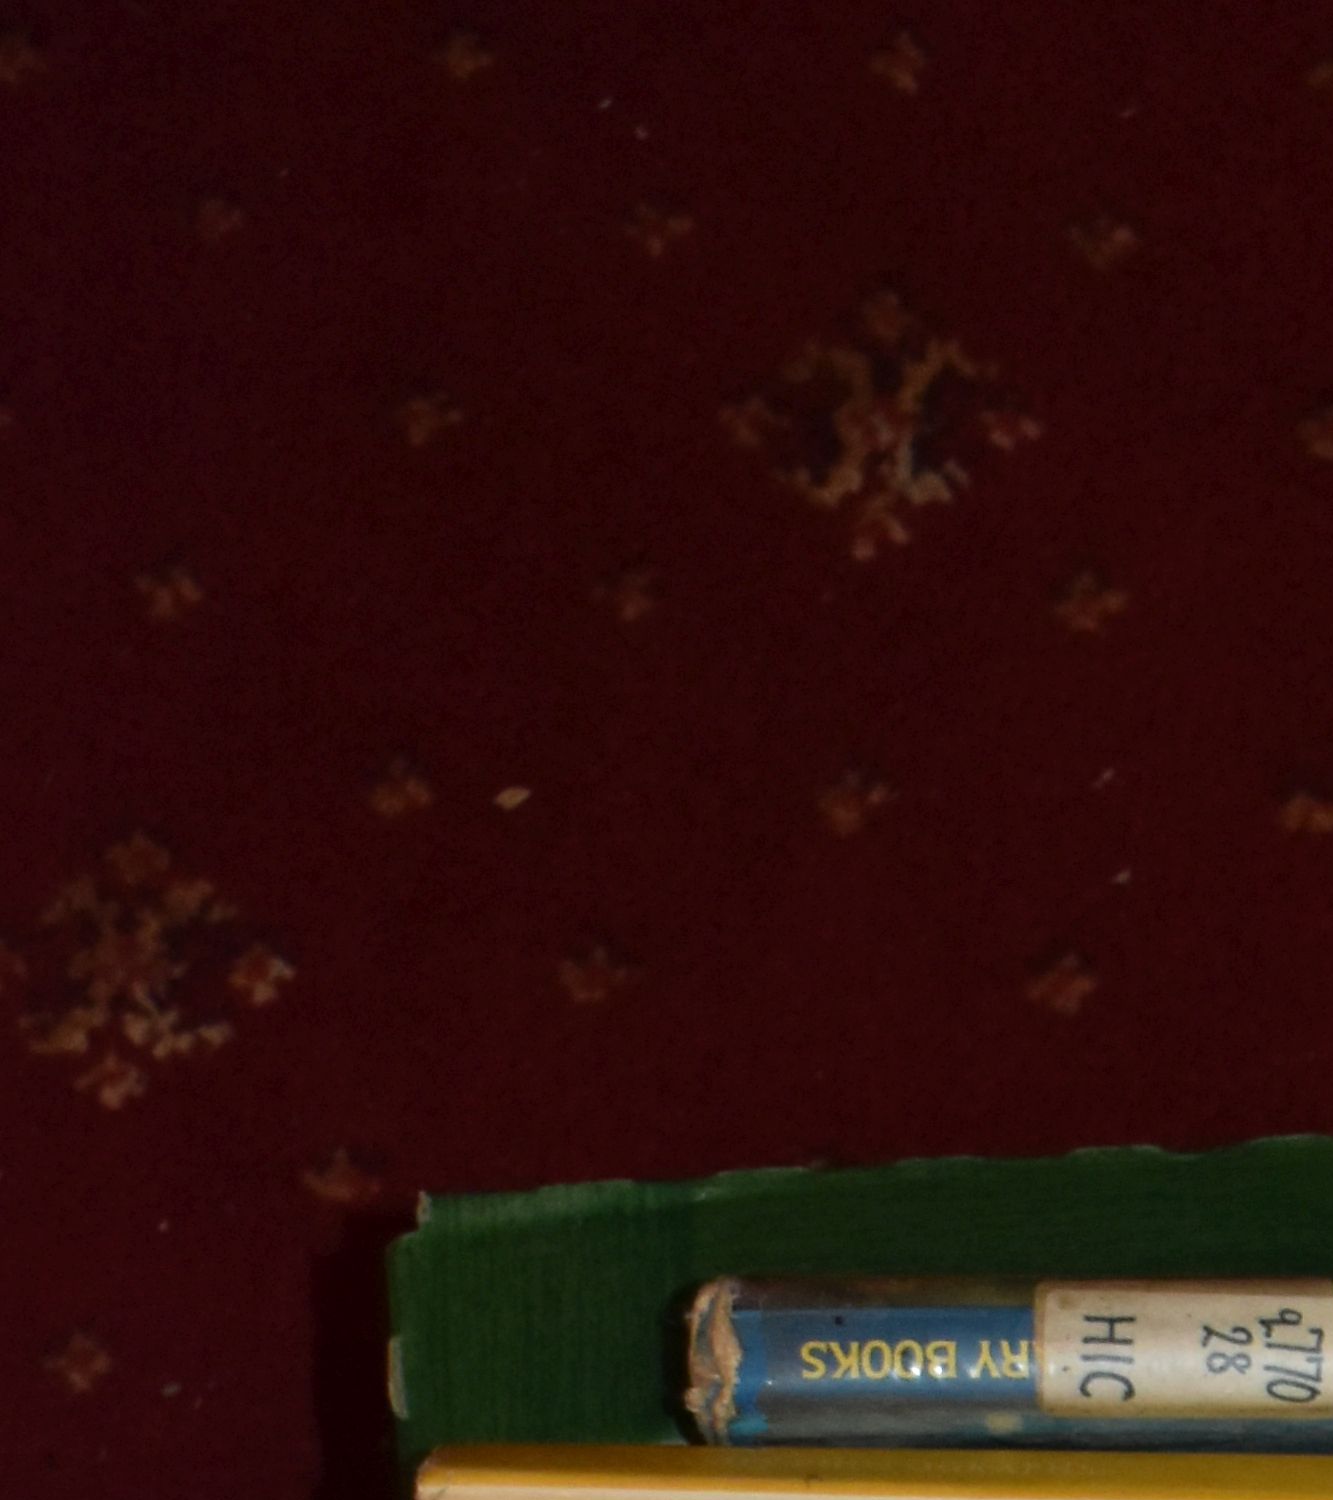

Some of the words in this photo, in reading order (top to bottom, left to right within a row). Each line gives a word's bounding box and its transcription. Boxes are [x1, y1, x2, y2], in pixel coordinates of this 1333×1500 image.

[801, 1339, 958, 1382] BOOKS
[1079, 1313, 1137, 1403] HIC
[1202, 1323, 1255, 1376] 28
